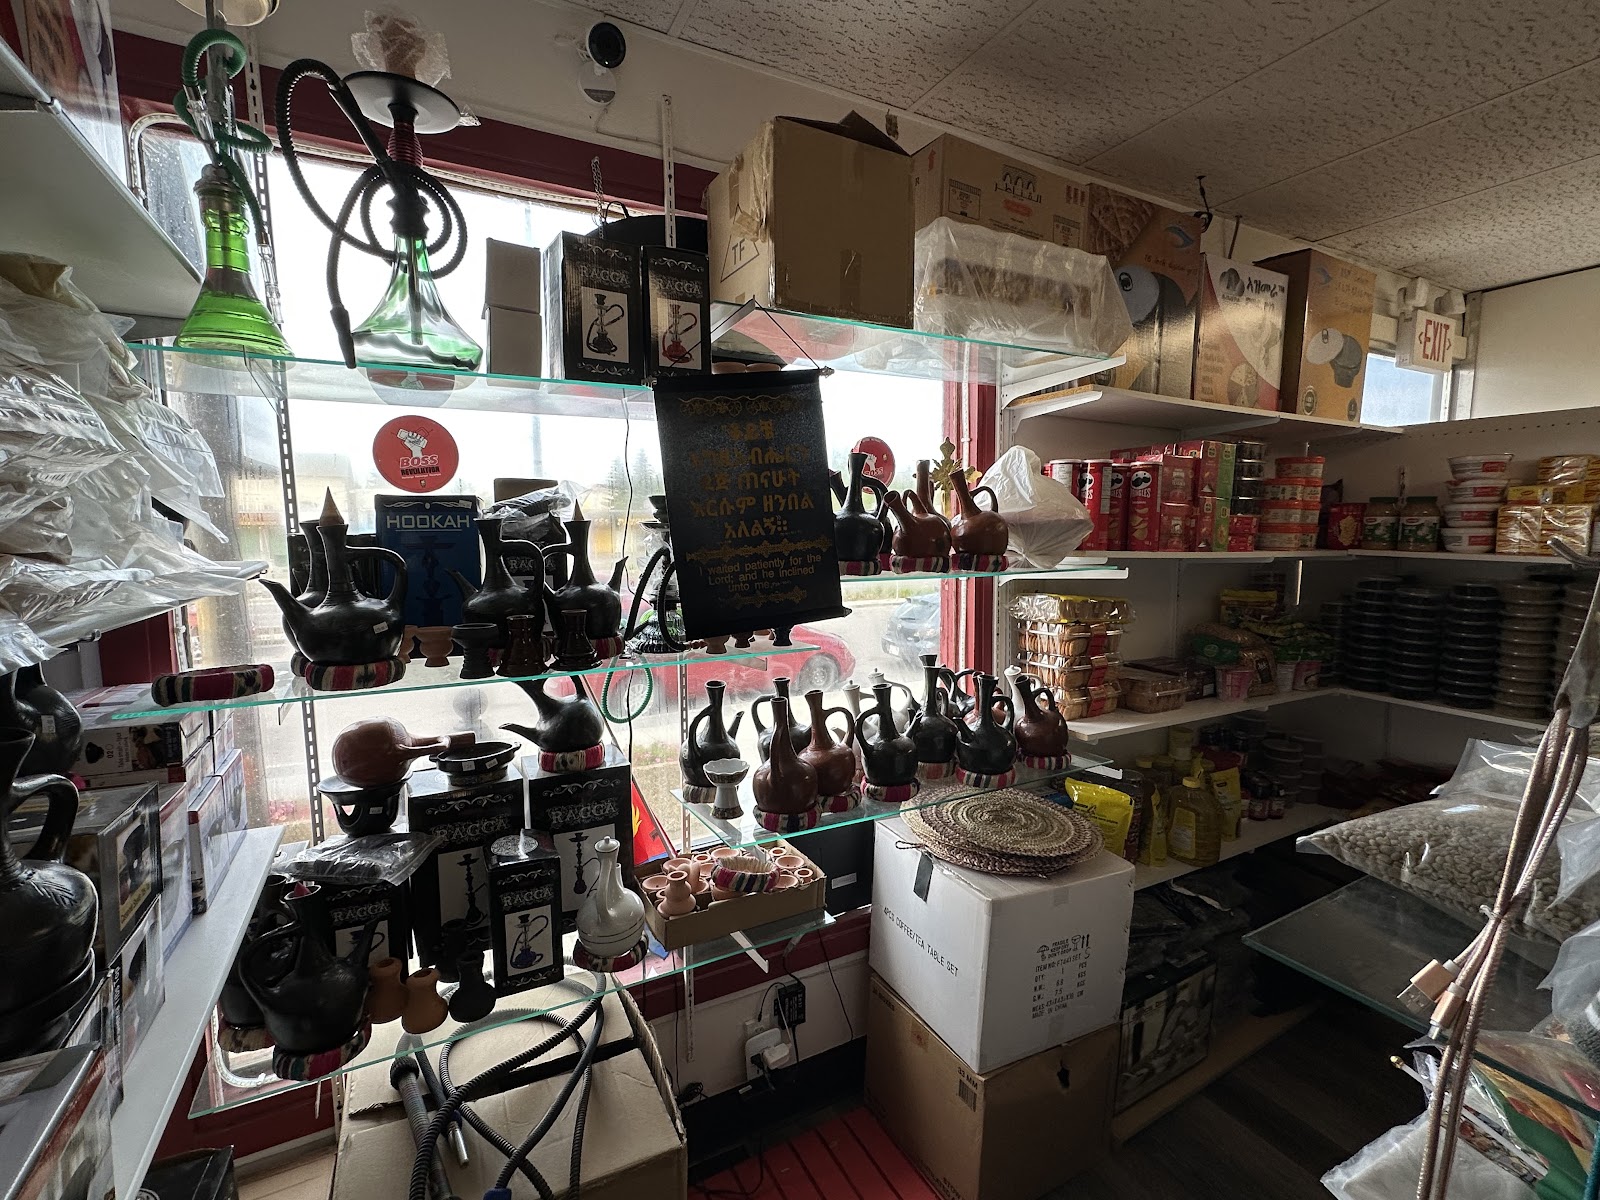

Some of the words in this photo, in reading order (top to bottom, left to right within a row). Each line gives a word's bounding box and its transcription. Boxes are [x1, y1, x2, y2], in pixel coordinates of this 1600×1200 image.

[1422, 318, 1450, 363] EXIT
[399, 454, 439, 469] BOSS
[400, 466, 441, 476] REVOLUTION
[386, 514, 471, 529] HOOKAH
[706, 562, 741, 576] waited
[744, 557, 785, 572] patiently
[789, 555, 802, 567] for
[807, 553, 822, 563] the
[738, 571, 758, 582] and
[762, 569, 775, 579] he
[779, 565, 815, 577] inclined
[727, 582, 751, 593] unto
[550, 803, 618, 824] RAGGA
[895, 916, 925, 950] COFFEE/TEA
[926, 944, 945, 967] TABLE
[946, 961, 959, 977] SET
